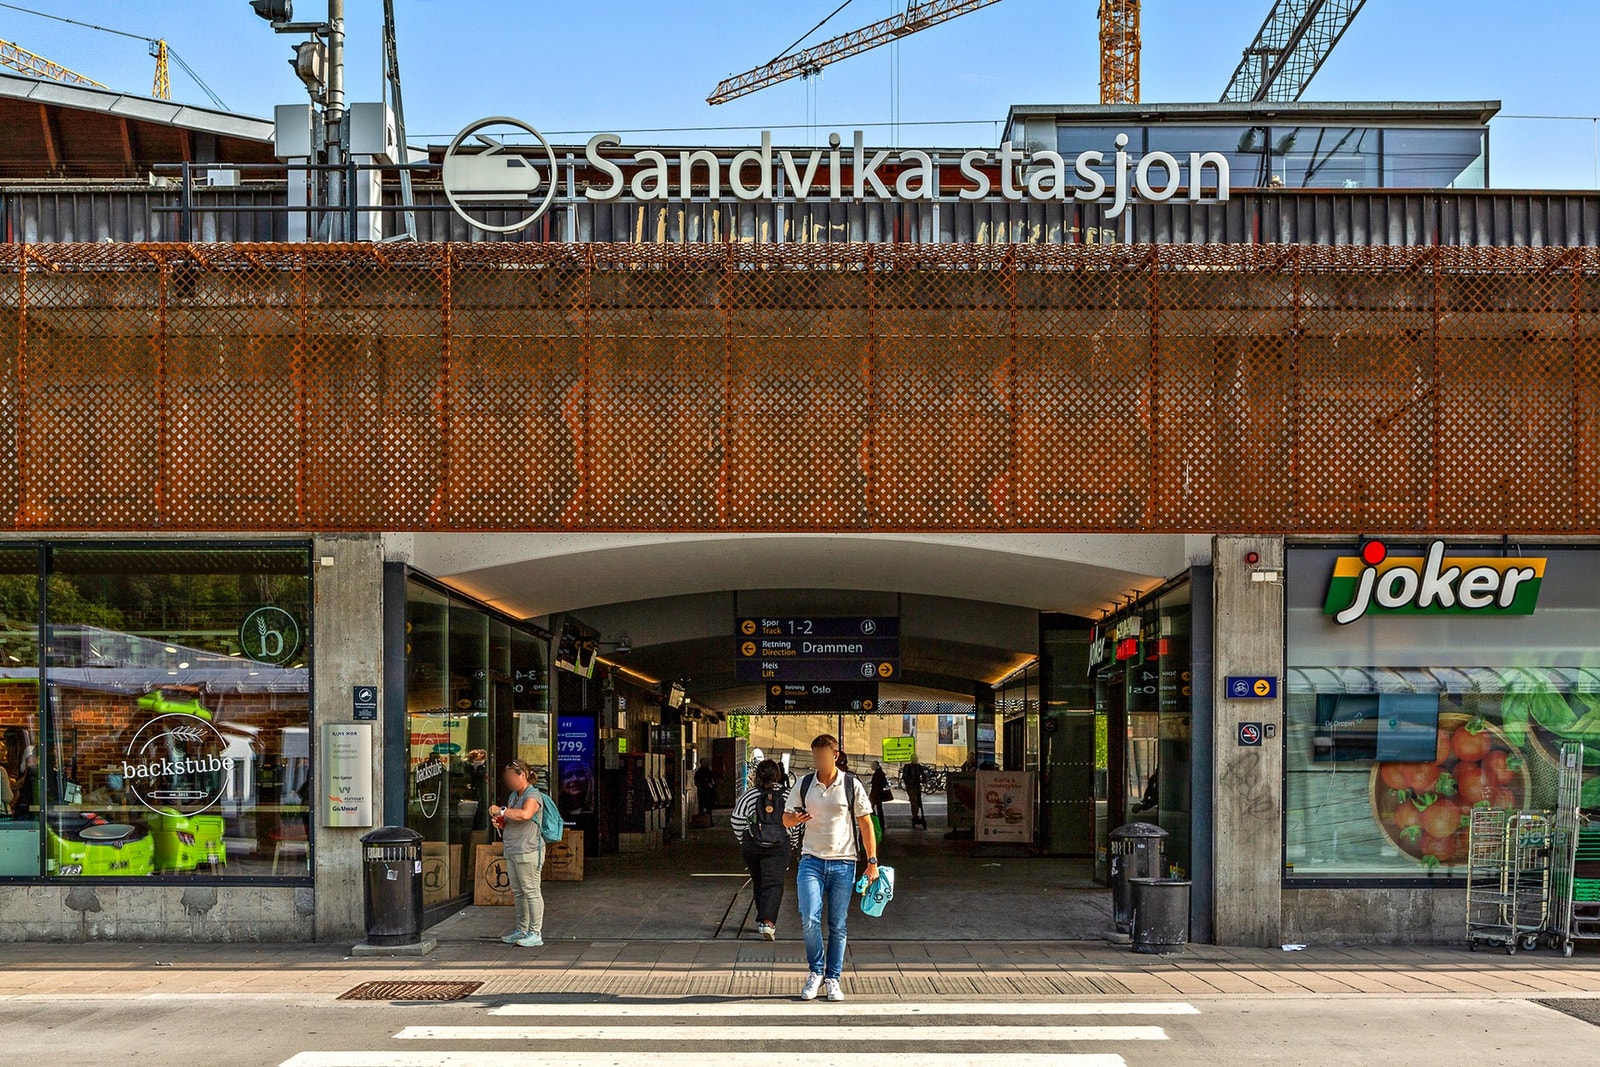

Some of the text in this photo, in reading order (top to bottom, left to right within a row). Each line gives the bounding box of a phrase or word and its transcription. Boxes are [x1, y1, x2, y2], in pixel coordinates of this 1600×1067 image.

[585, 130, 1230, 220] Sandvika stasjon
[1334, 539, 1535, 625] joker
[762, 619, 780, 628] Spor
[788, 620, 813, 634] 1-2
[256, 616, 284, 657] b
[762, 641, 791, 649] Retning
[802, 641, 863, 653] Drammen
[762, 670, 775, 678] Lift
[812, 685, 831, 694] Oslo
[121, 753, 235, 780] backstube
